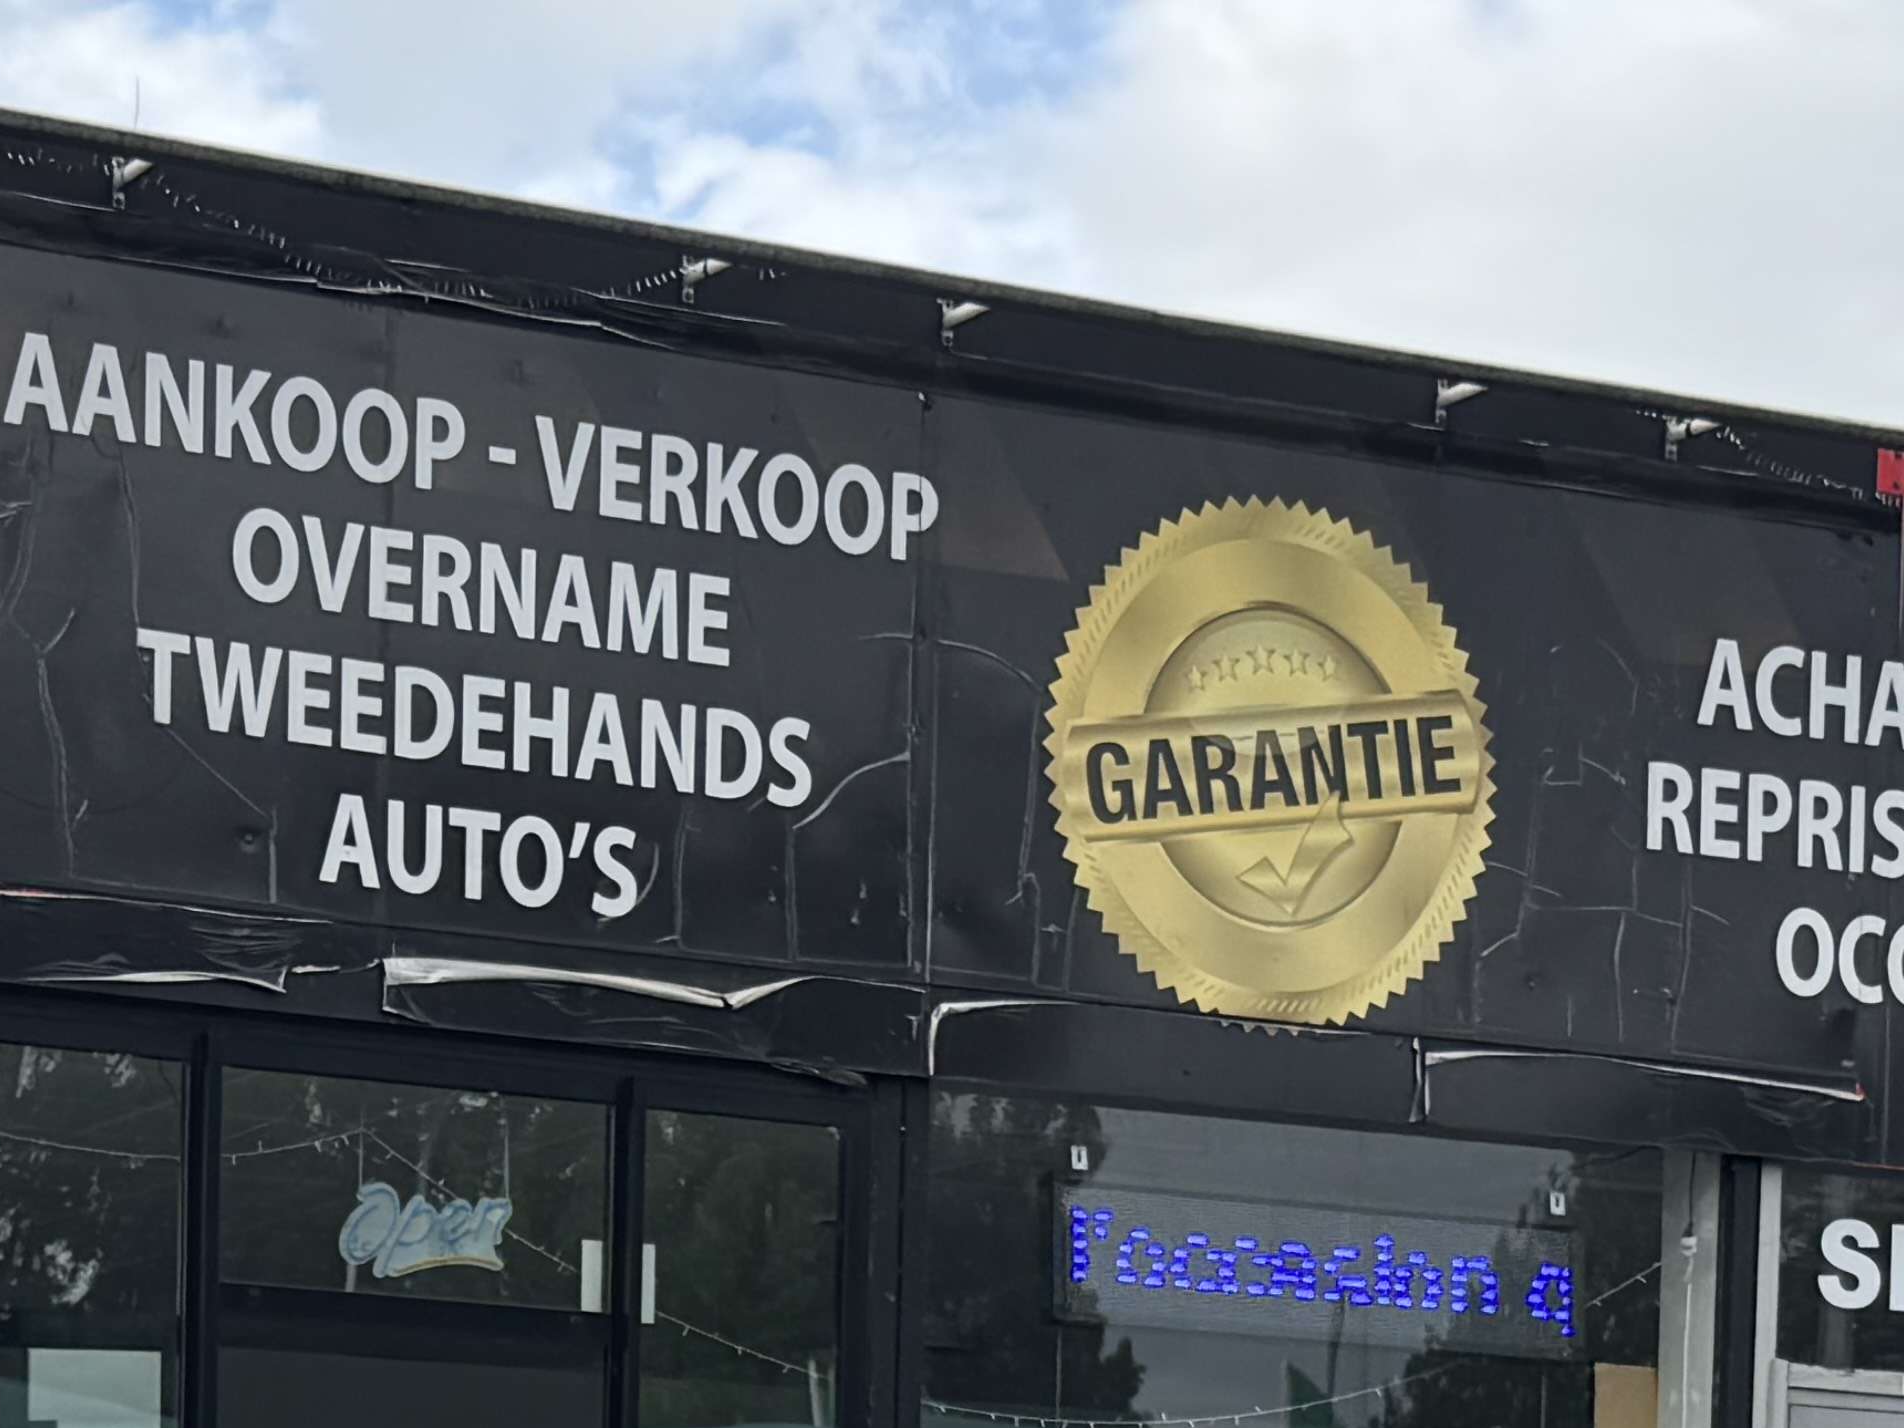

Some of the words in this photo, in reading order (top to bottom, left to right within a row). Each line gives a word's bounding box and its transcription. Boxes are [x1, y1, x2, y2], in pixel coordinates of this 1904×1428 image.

[2, 331, 466, 492] AANKOOP
[533, 413, 941, 563] VERKOOP
[230, 506, 732, 669] OVERNAME
[135, 627, 814, 809] TWEEDEHANDS
[1084, 712, 1464, 826] GARANTIE
[317, 793, 640, 920] AUTO'S
